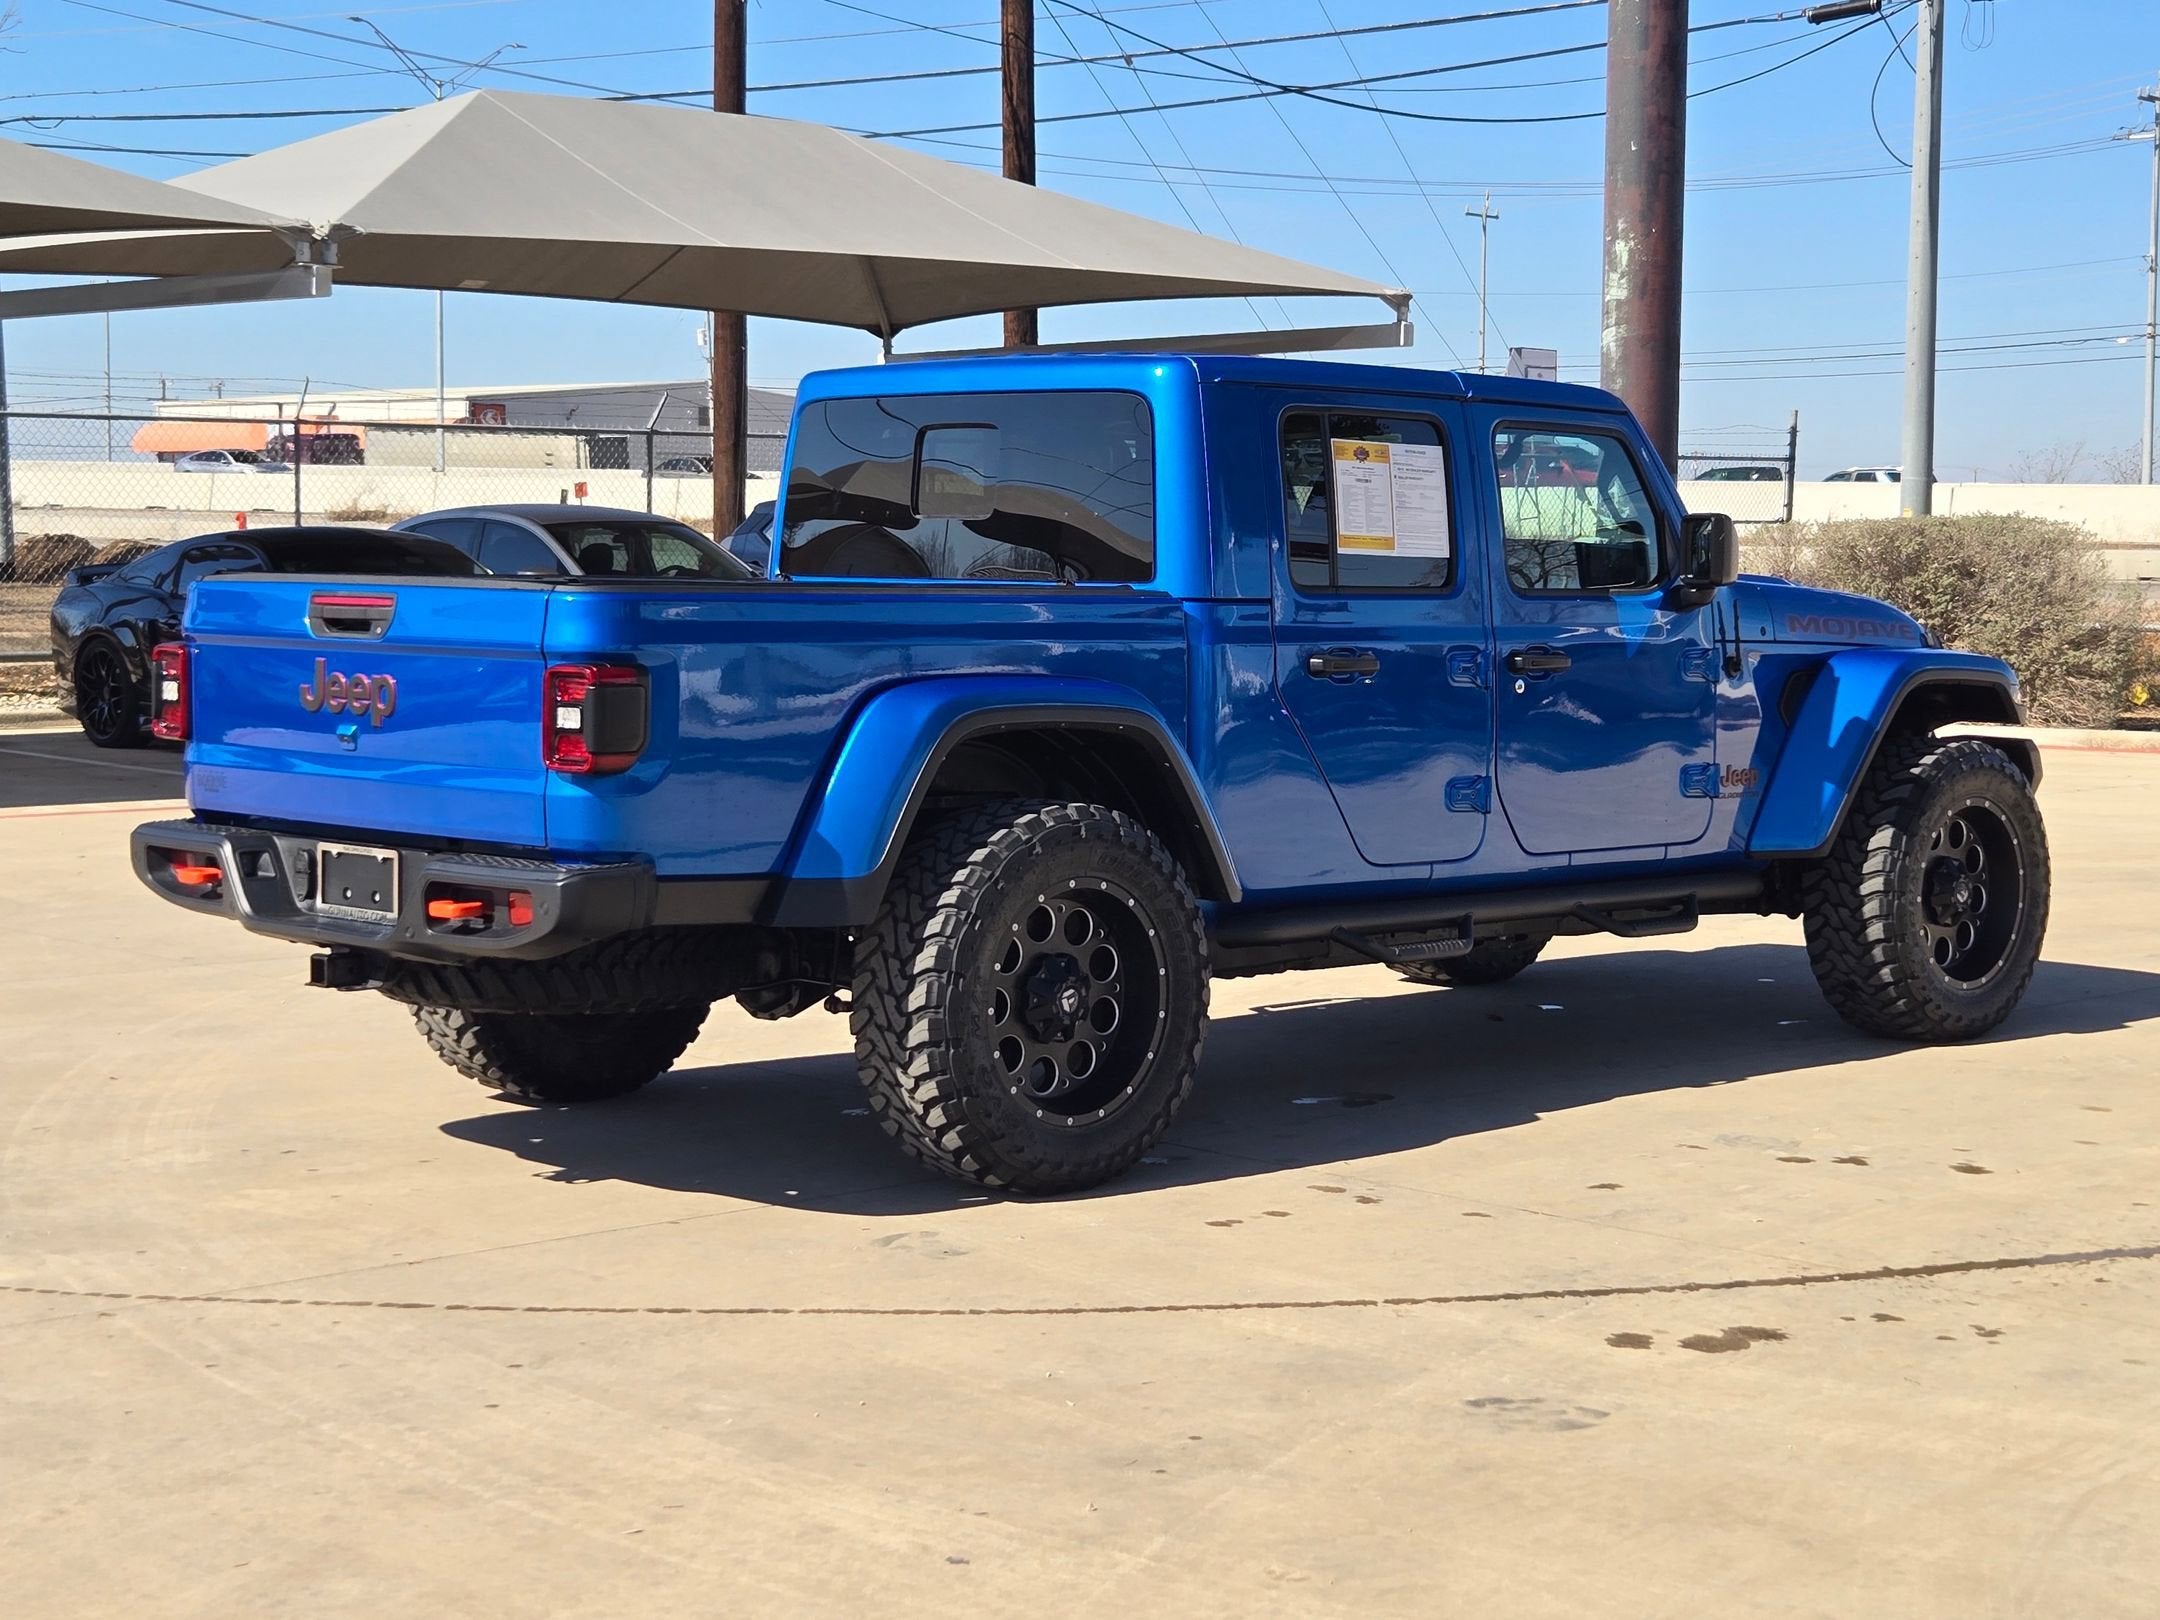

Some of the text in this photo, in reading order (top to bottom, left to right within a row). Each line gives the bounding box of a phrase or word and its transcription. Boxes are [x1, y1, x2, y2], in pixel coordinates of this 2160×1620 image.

[1788, 615, 1915, 640] MOJAVE
[300, 657, 397, 727] Jeep
[1720, 764, 1759, 789] Jeep
